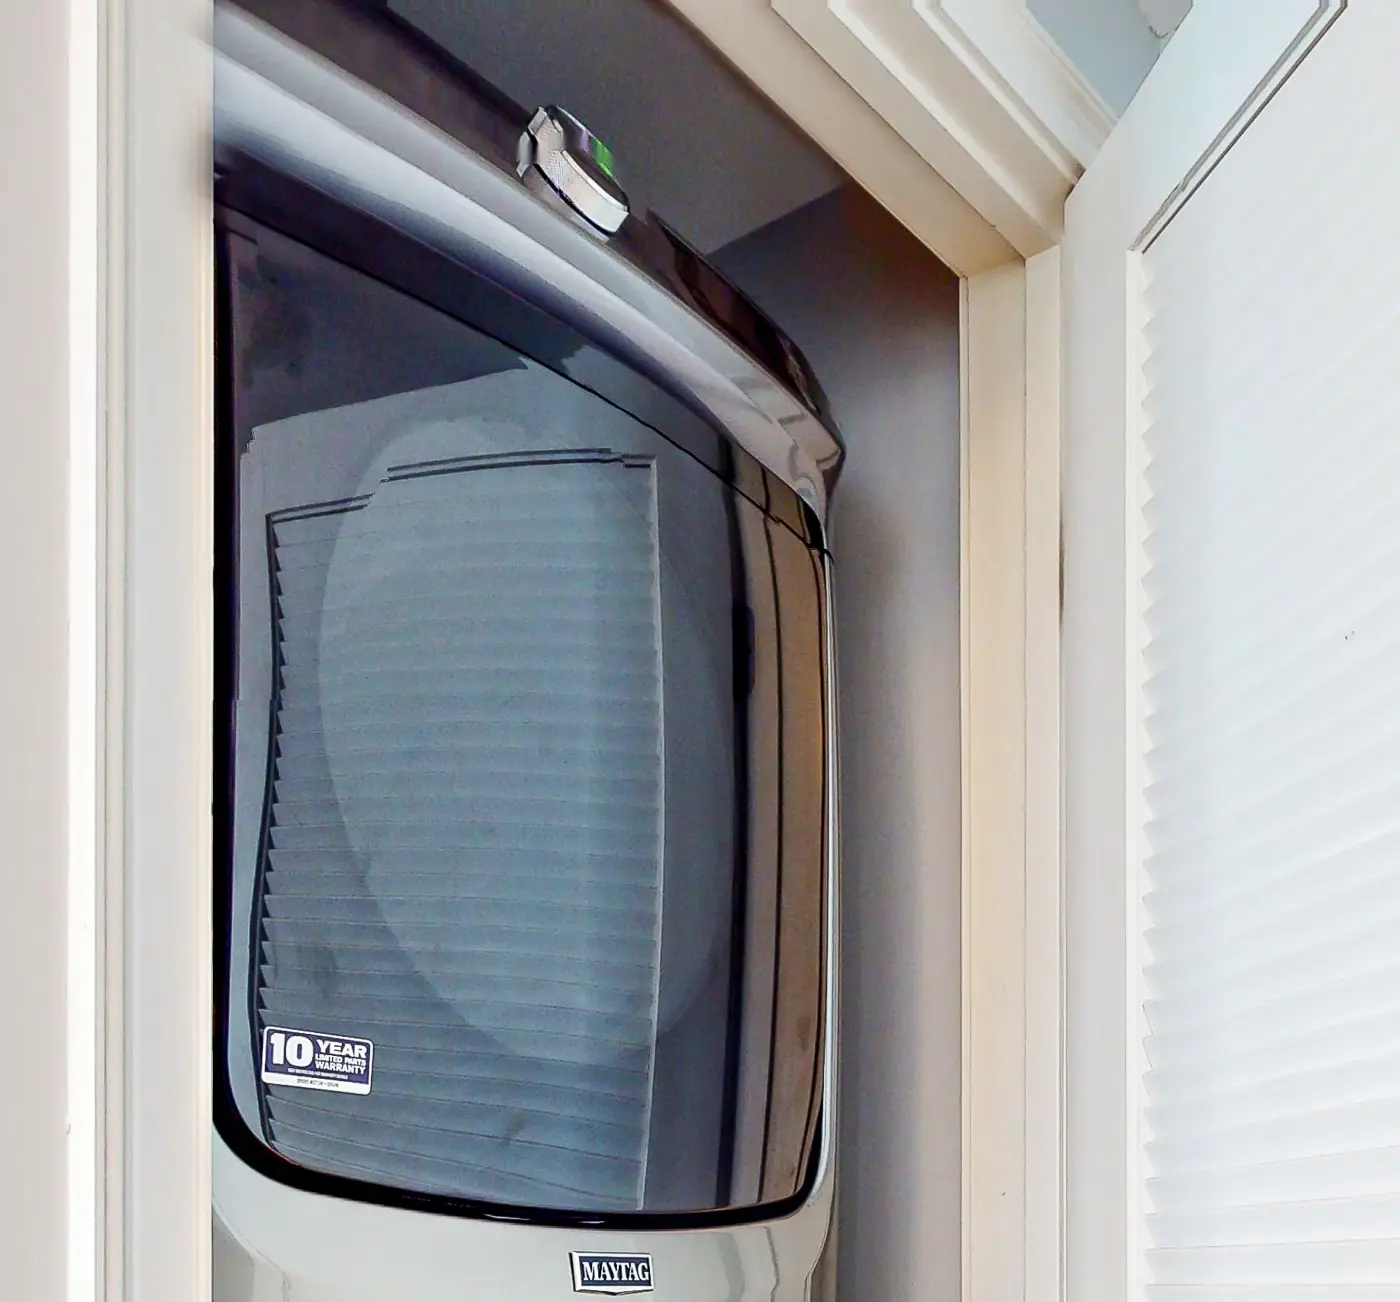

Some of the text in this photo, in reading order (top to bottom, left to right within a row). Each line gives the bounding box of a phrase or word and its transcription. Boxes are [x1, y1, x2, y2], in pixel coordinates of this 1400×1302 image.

[270, 1032, 314, 1068] 10
[316, 1039, 367, 1058] YEAR
[315, 1053, 367, 1066] LIMITED PARTS
[315, 1061, 366, 1075] WARRANTY
[582, 1261, 650, 1281] MAYTAG
